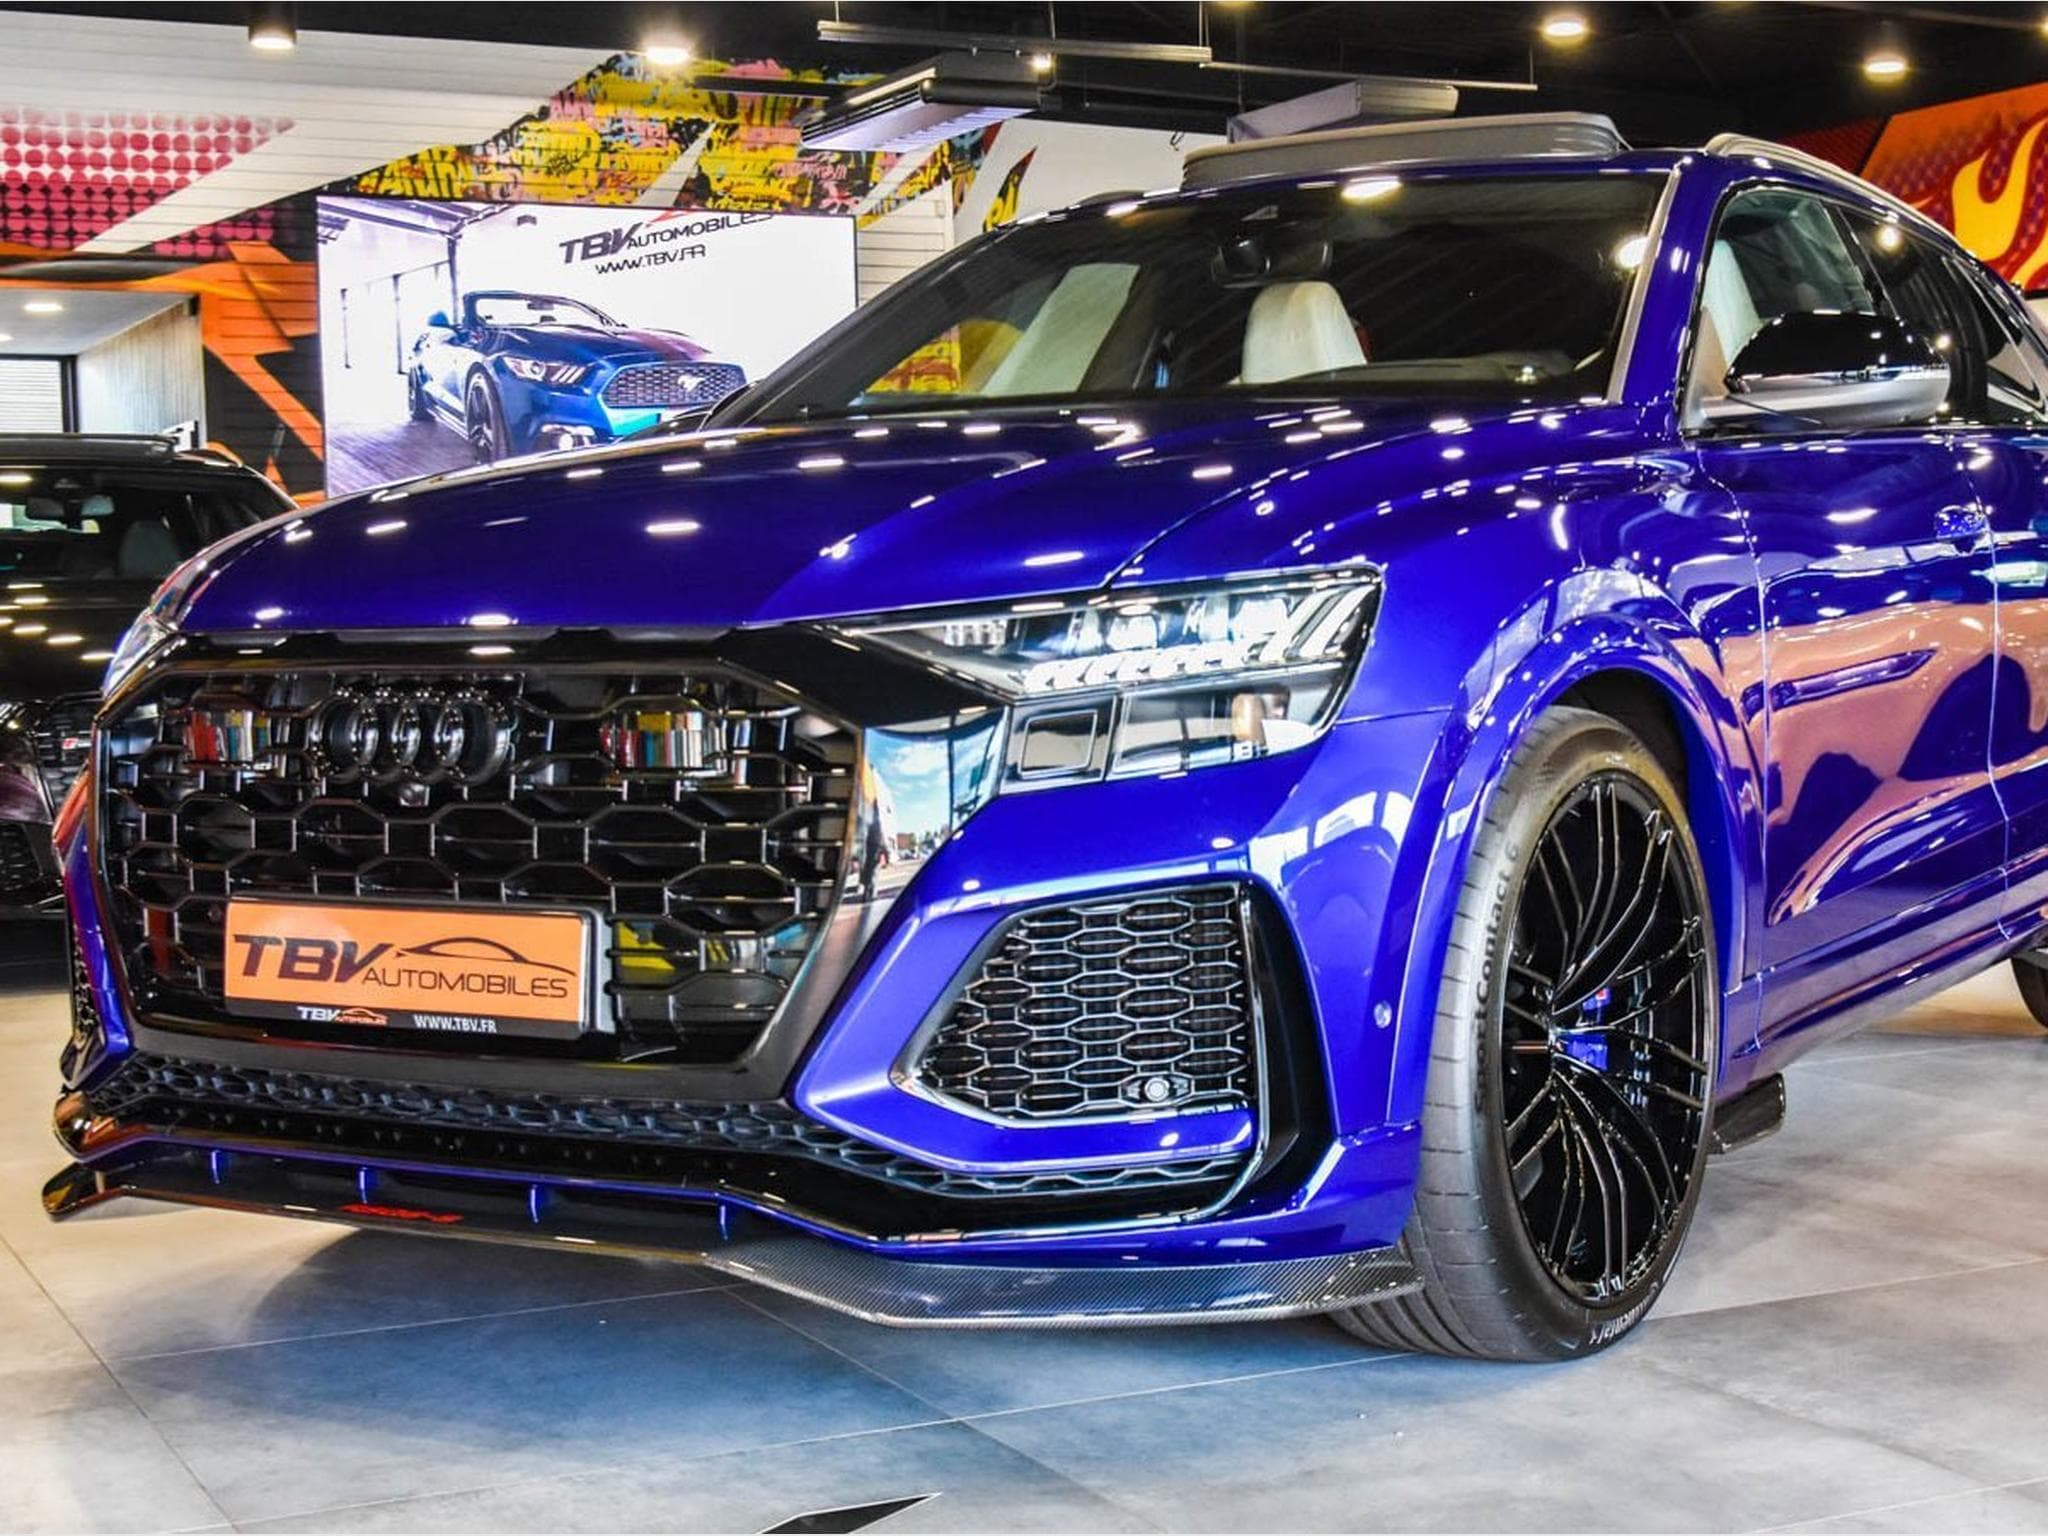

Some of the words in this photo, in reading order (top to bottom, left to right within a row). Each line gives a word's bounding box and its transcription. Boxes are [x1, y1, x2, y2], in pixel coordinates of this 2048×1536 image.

[559, 221, 644, 264] TBV
[232, 934, 395, 983] TBV
[361, 967, 569, 999] AUTOMOBILES
[296, 1005, 341, 1022] TBV
[413, 1013, 498, 1034] WWW.TBV.FR
